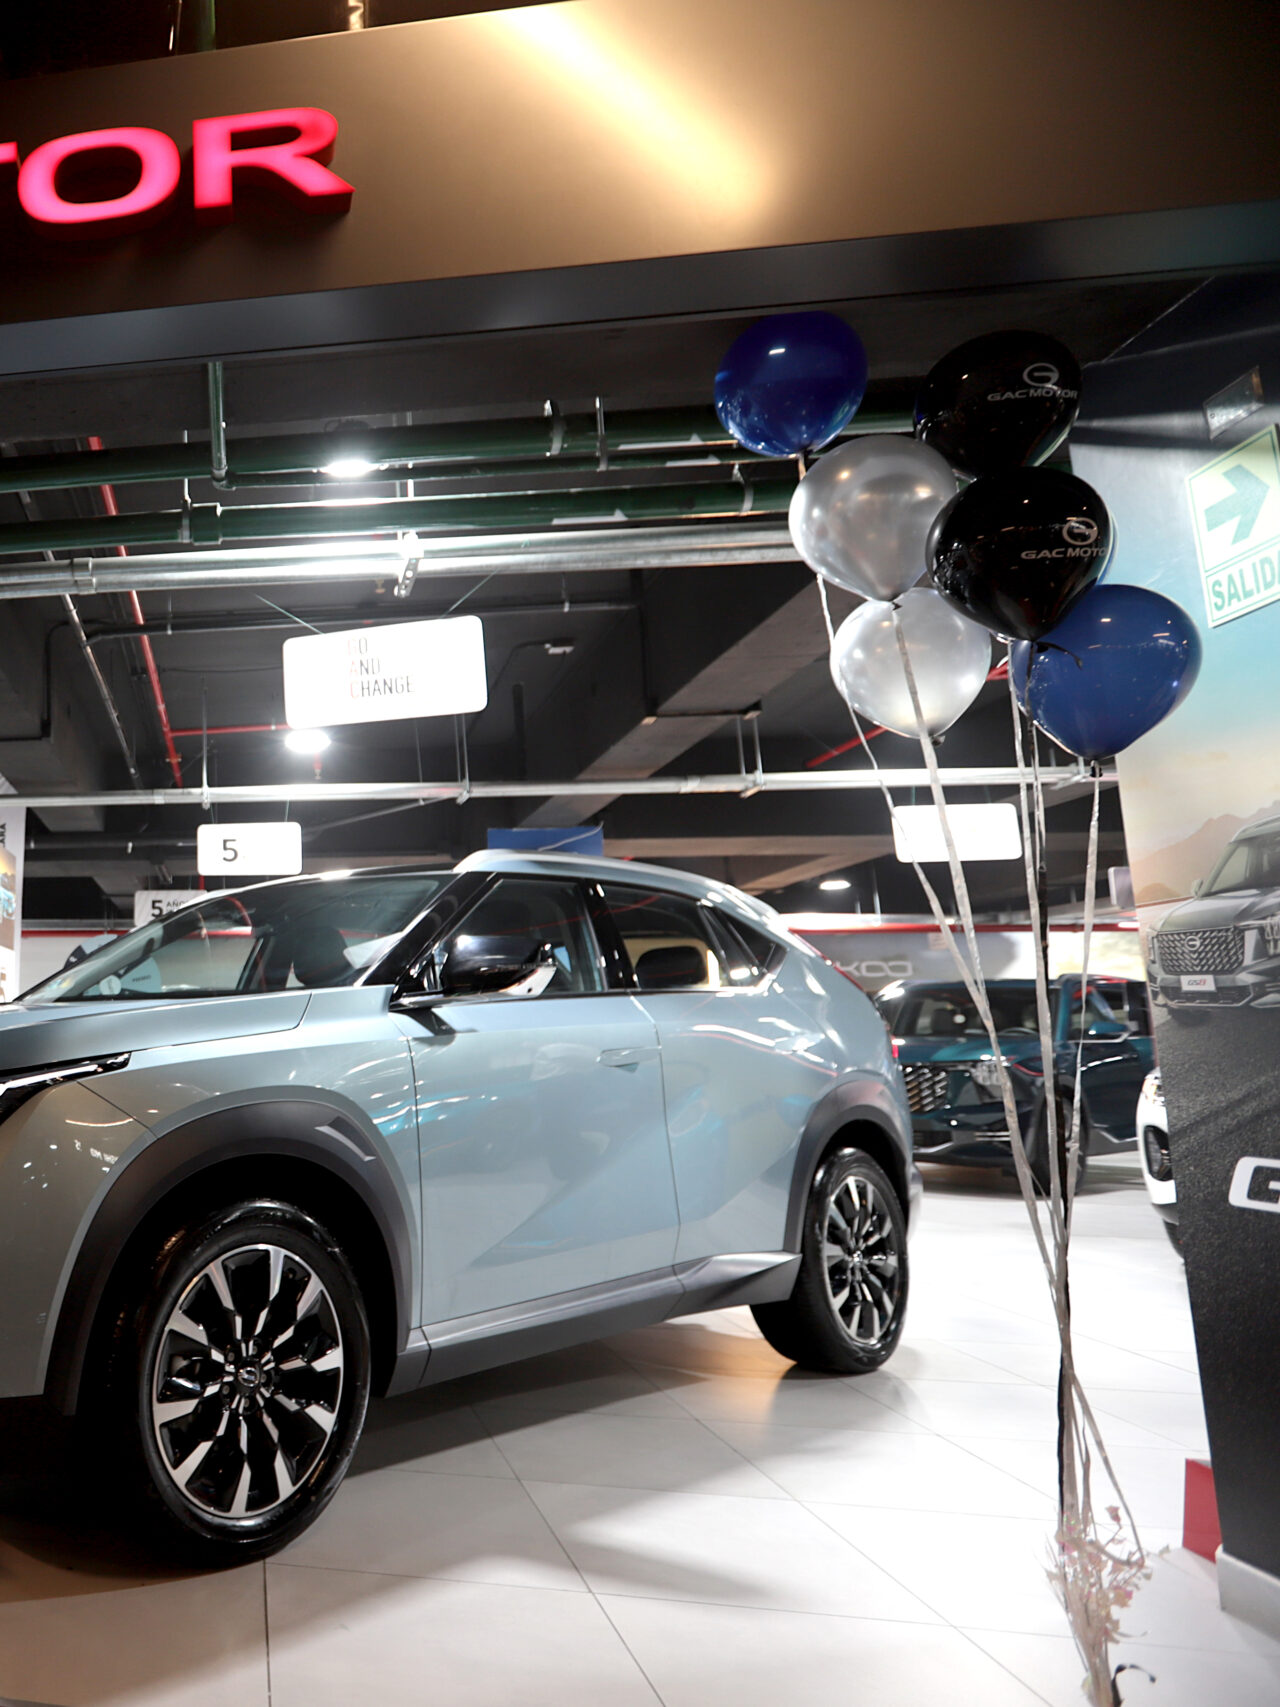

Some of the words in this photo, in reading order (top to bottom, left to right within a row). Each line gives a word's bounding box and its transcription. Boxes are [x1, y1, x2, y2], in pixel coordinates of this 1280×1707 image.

[987, 389, 1027, 401] GAC
[1021, 548, 1065, 559] GAC
[1067, 547, 1108, 558] MOTO
[1211, 549, 1280, 612] SALID
[350, 658, 381, 677] AND
[350, 675, 416, 700] CHANGE
[222, 839, 238, 862] 5
[151, 900, 163, 918] 5
